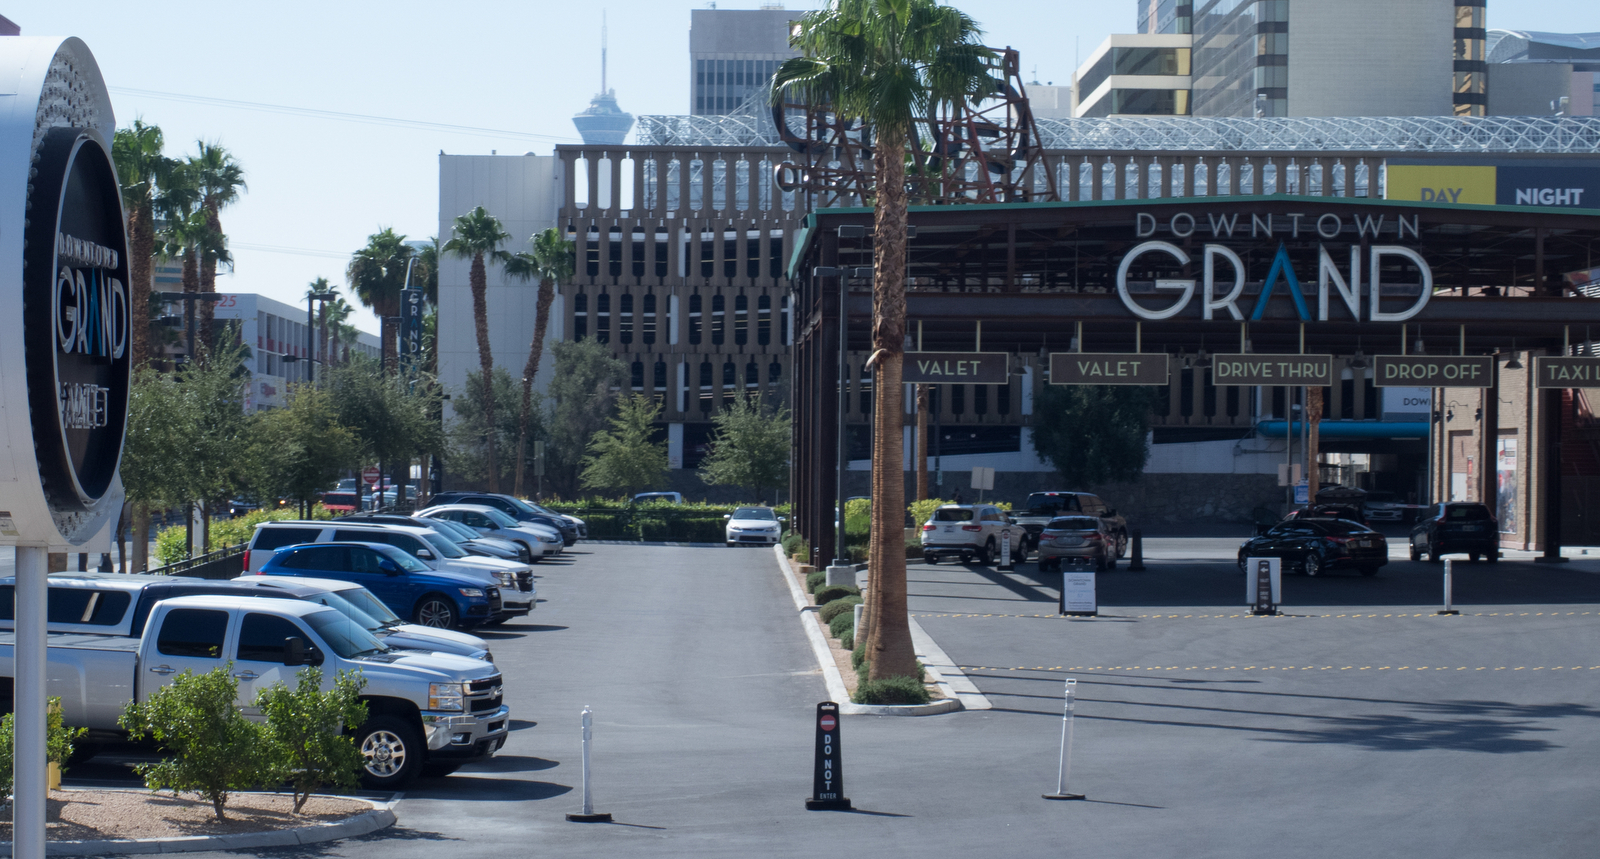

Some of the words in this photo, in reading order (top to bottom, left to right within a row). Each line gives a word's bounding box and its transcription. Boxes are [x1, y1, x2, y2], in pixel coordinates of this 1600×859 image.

[1421, 188, 1463, 203] DAY
[1516, 188, 1584, 205] NIGHT
[1136, 212, 1419, 238] DOWNTOWN
[59, 232, 118, 270] DOWNTOWN
[1116, 239, 1433, 322] GRAND
[57, 265, 127, 364] GRAND
[409, 293, 418, 353] GRAND
[917, 360, 981, 375] VALET
[1077, 361, 1141, 376] VALET
[1218, 362, 1272, 377] DRIVE
[1277, 362, 1327, 377] THRU
[1385, 363, 1438, 379] DROP
[1443, 364, 1481, 379] OFF
[1547, 365, 1590, 380] TAXI
[824, 734, 832, 755] DO
[824, 759, 832, 791] NOT
